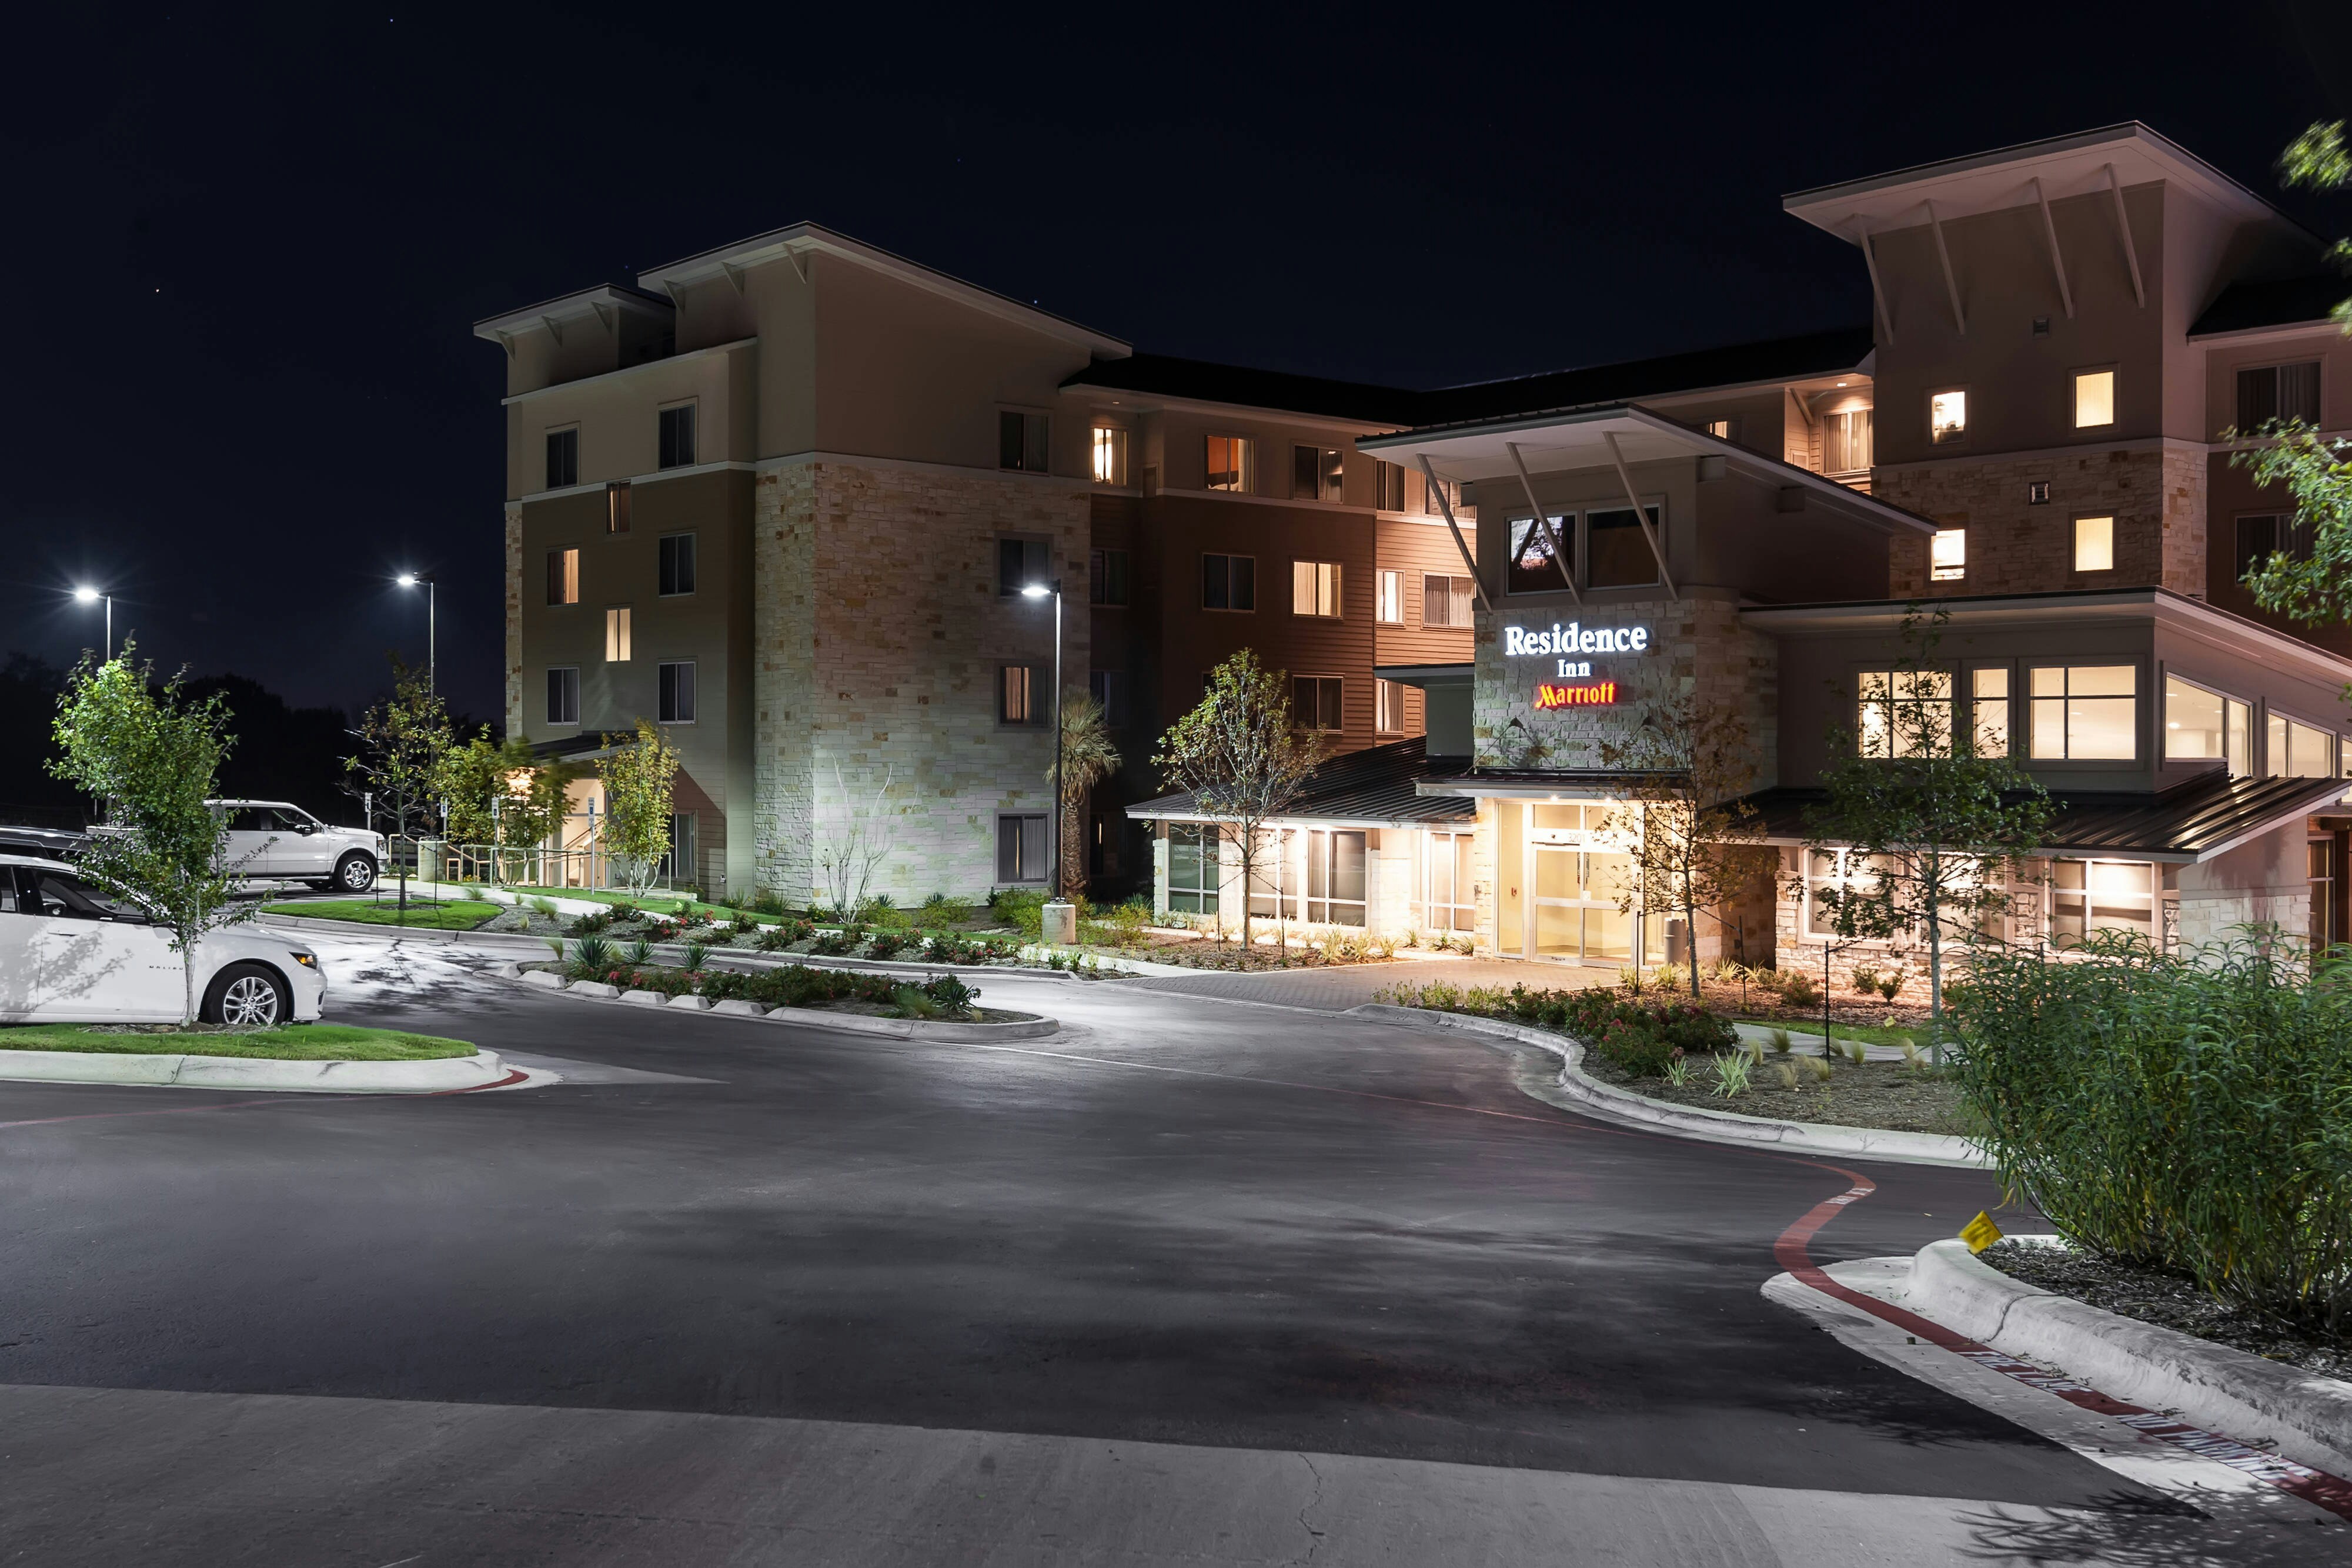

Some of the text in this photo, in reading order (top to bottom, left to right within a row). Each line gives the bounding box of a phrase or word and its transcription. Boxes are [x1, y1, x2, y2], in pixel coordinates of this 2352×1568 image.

[1505, 622, 1647, 656] Residence
[1558, 659, 1591, 677] Inn
[1535, 682, 1615, 709] Marriott
[1955, 1351, 2093, 1393] FIRE LANE
[2113, 1413, 2313, 1480] NO PARKING
